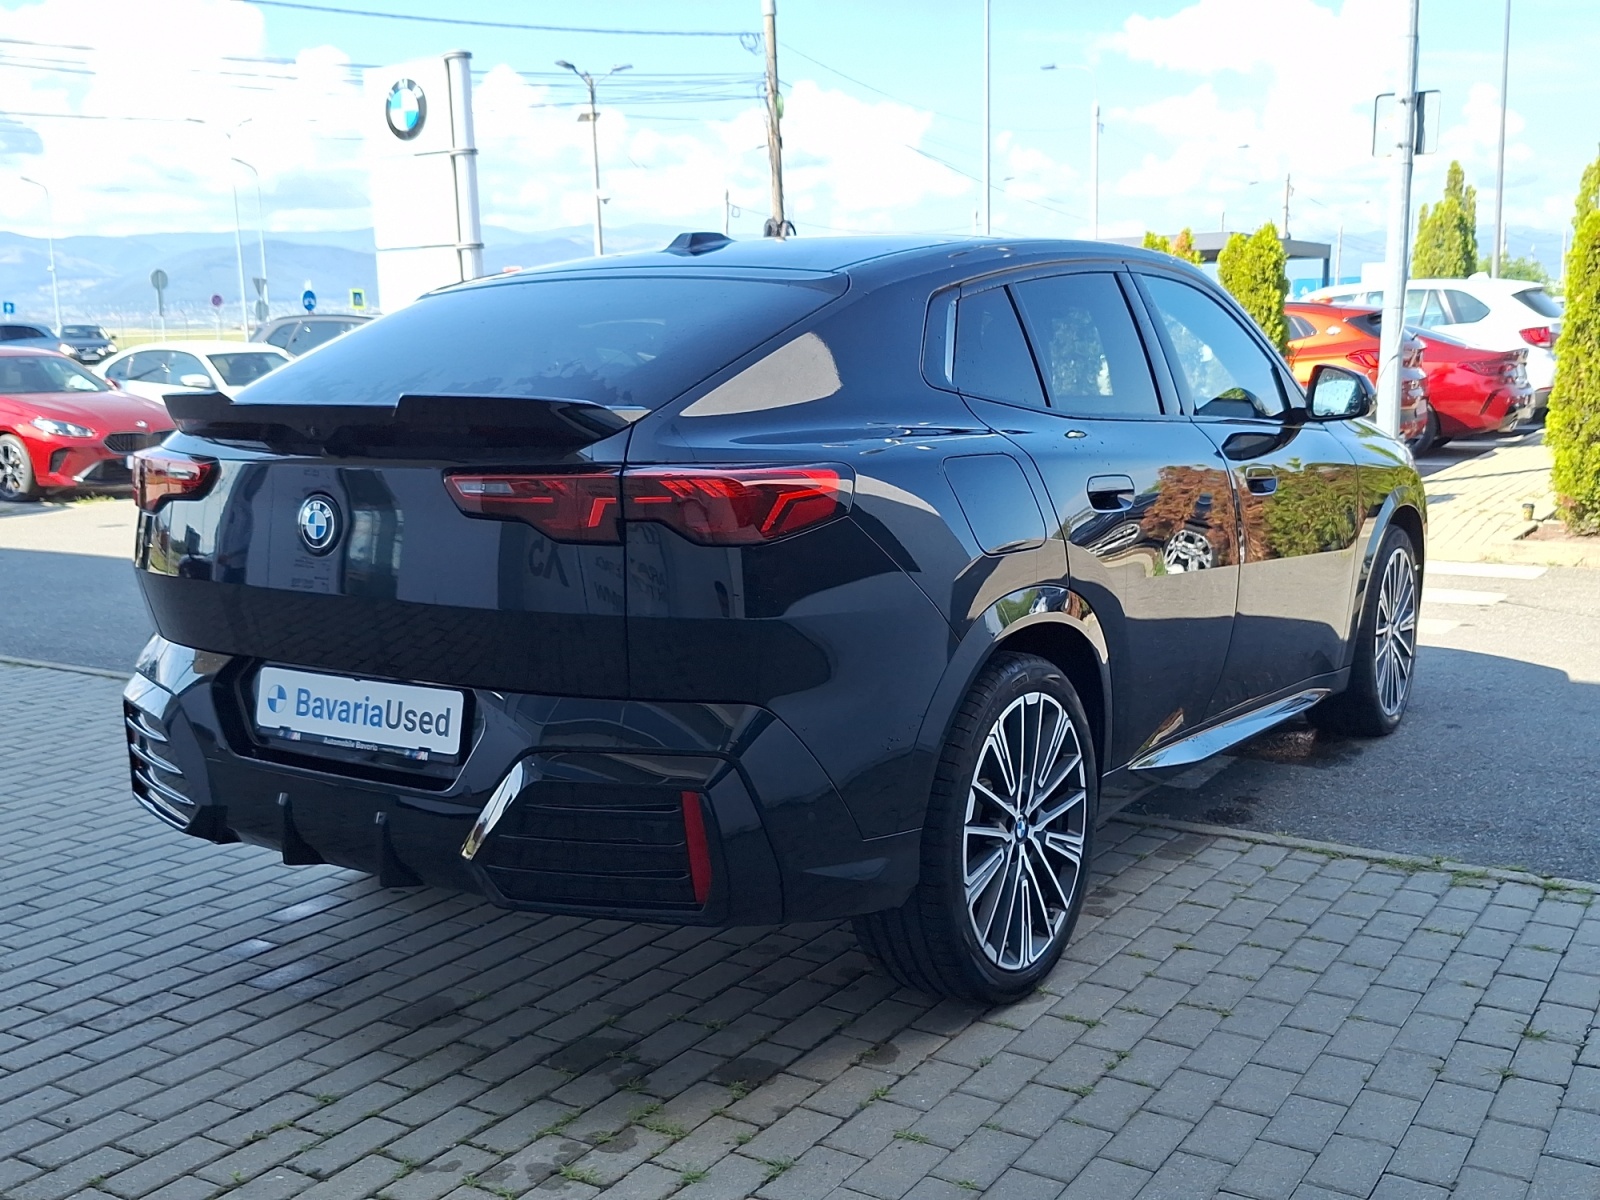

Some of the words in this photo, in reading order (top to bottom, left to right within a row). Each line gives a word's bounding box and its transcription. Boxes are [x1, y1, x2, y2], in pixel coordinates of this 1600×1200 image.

[295, 687, 452, 738] BavariaUsed
[323, 737, 355, 749] Automobile
[355, 741, 378, 752] Bavaria
